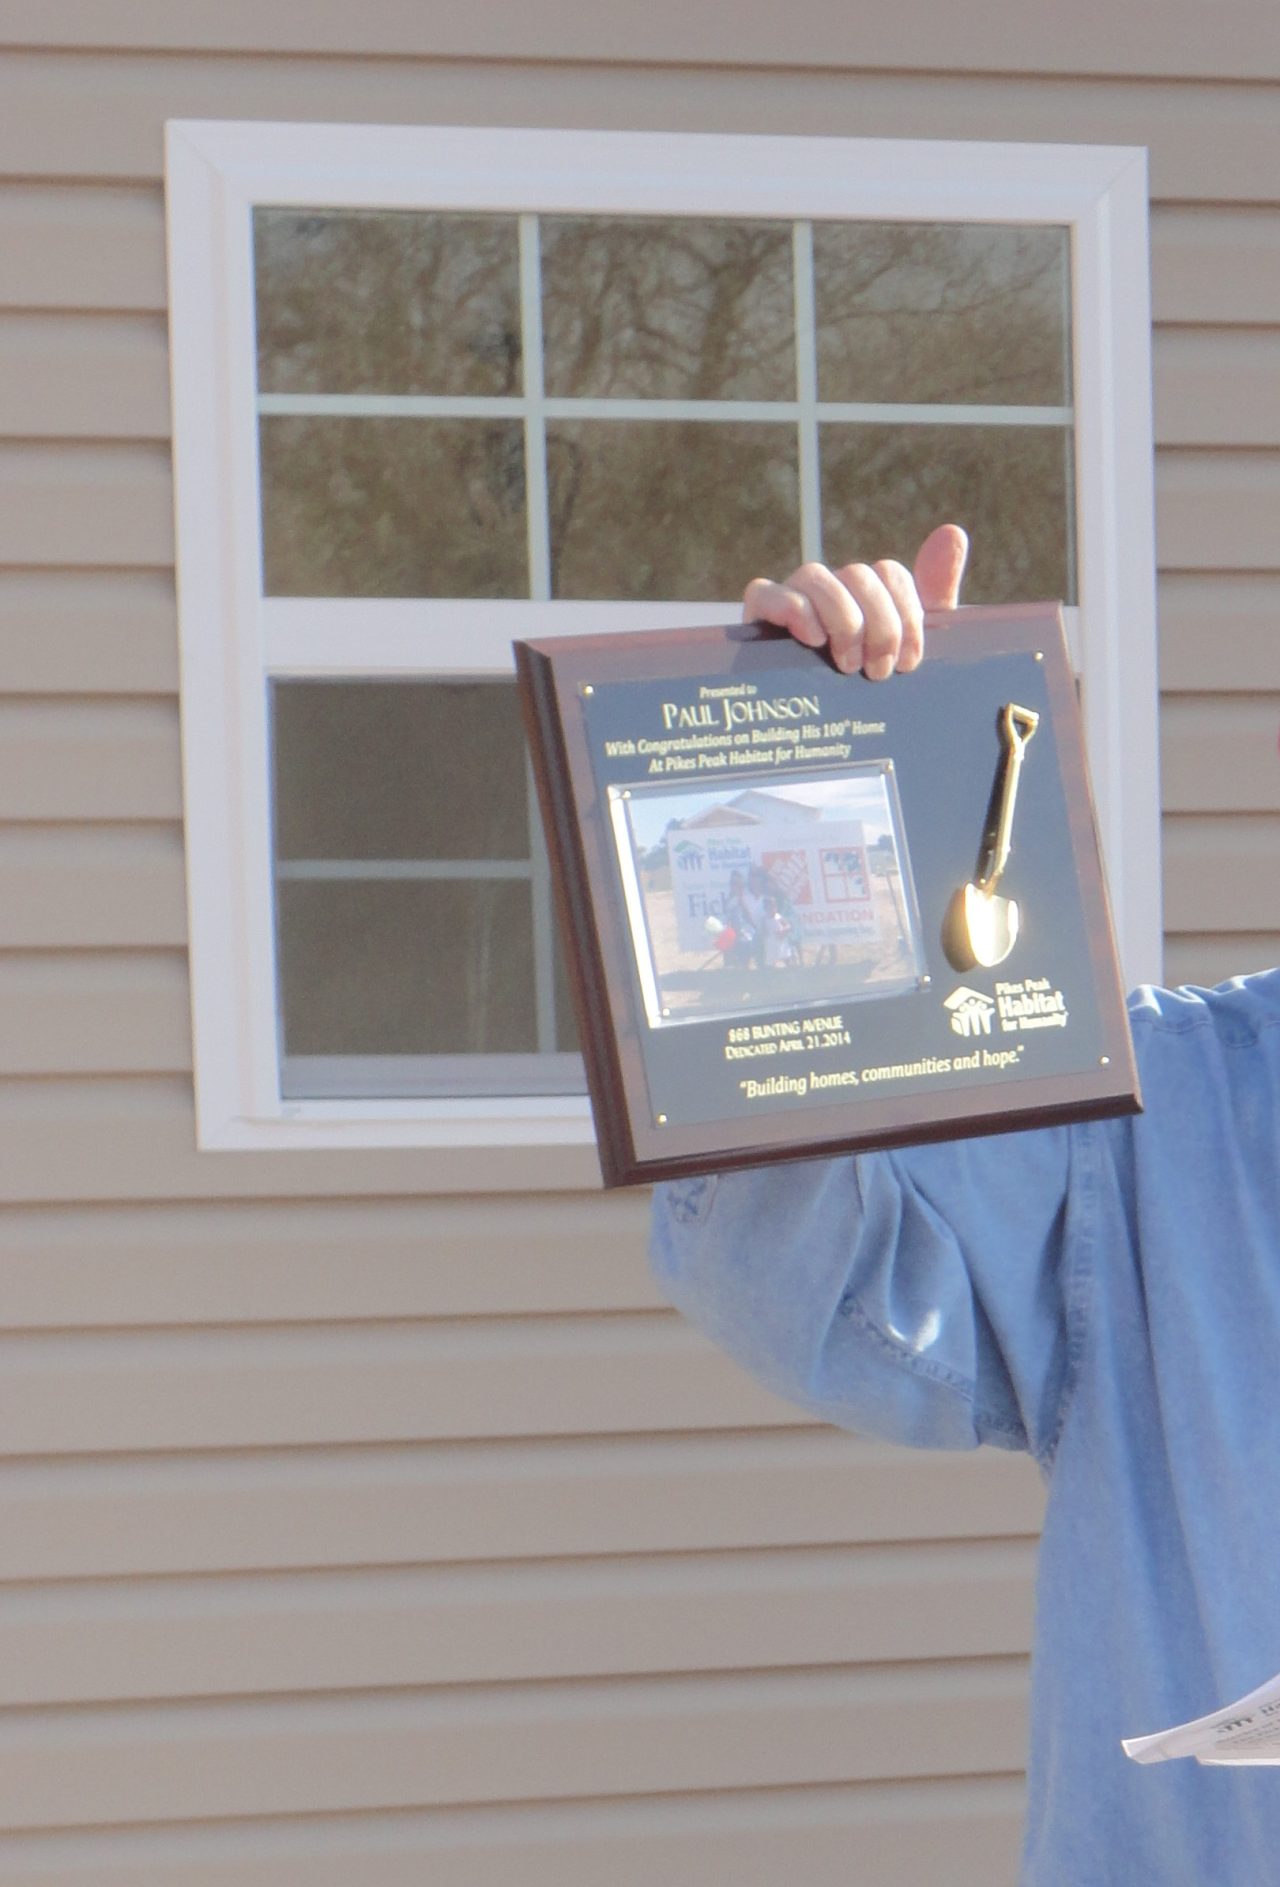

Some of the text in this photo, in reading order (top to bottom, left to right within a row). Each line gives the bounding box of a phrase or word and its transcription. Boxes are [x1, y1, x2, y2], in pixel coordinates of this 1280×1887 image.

[700, 683, 758, 699] Presented to
[662, 695, 820, 731] PAUL JOHNSON
[605, 739, 636, 757] With
[637, 733, 734, 756] Congratulations
[734, 733, 750, 746] on
[751, 726, 800, 744] Building
[801, 723, 822, 740] His
[852, 720, 886, 736] Home
[648, 741, 852, 774] At Pikes Peak Habitat for Humanity
[995, 977, 1051, 996] Pikes Peak
[997, 990, 1066, 1018] Habitat
[751, 1020, 801, 1040] BUNTING
[802, 1015, 844, 1033] AVENUE
[1001, 1018, 1018, 1032] for
[724, 1042, 778, 1060] DEDICATED
[779, 1038, 806, 1053] APRIL
[809, 1070, 859, 1089] homes,
[861, 1057, 951, 1082] communities
[952, 1051, 980, 1070] and
